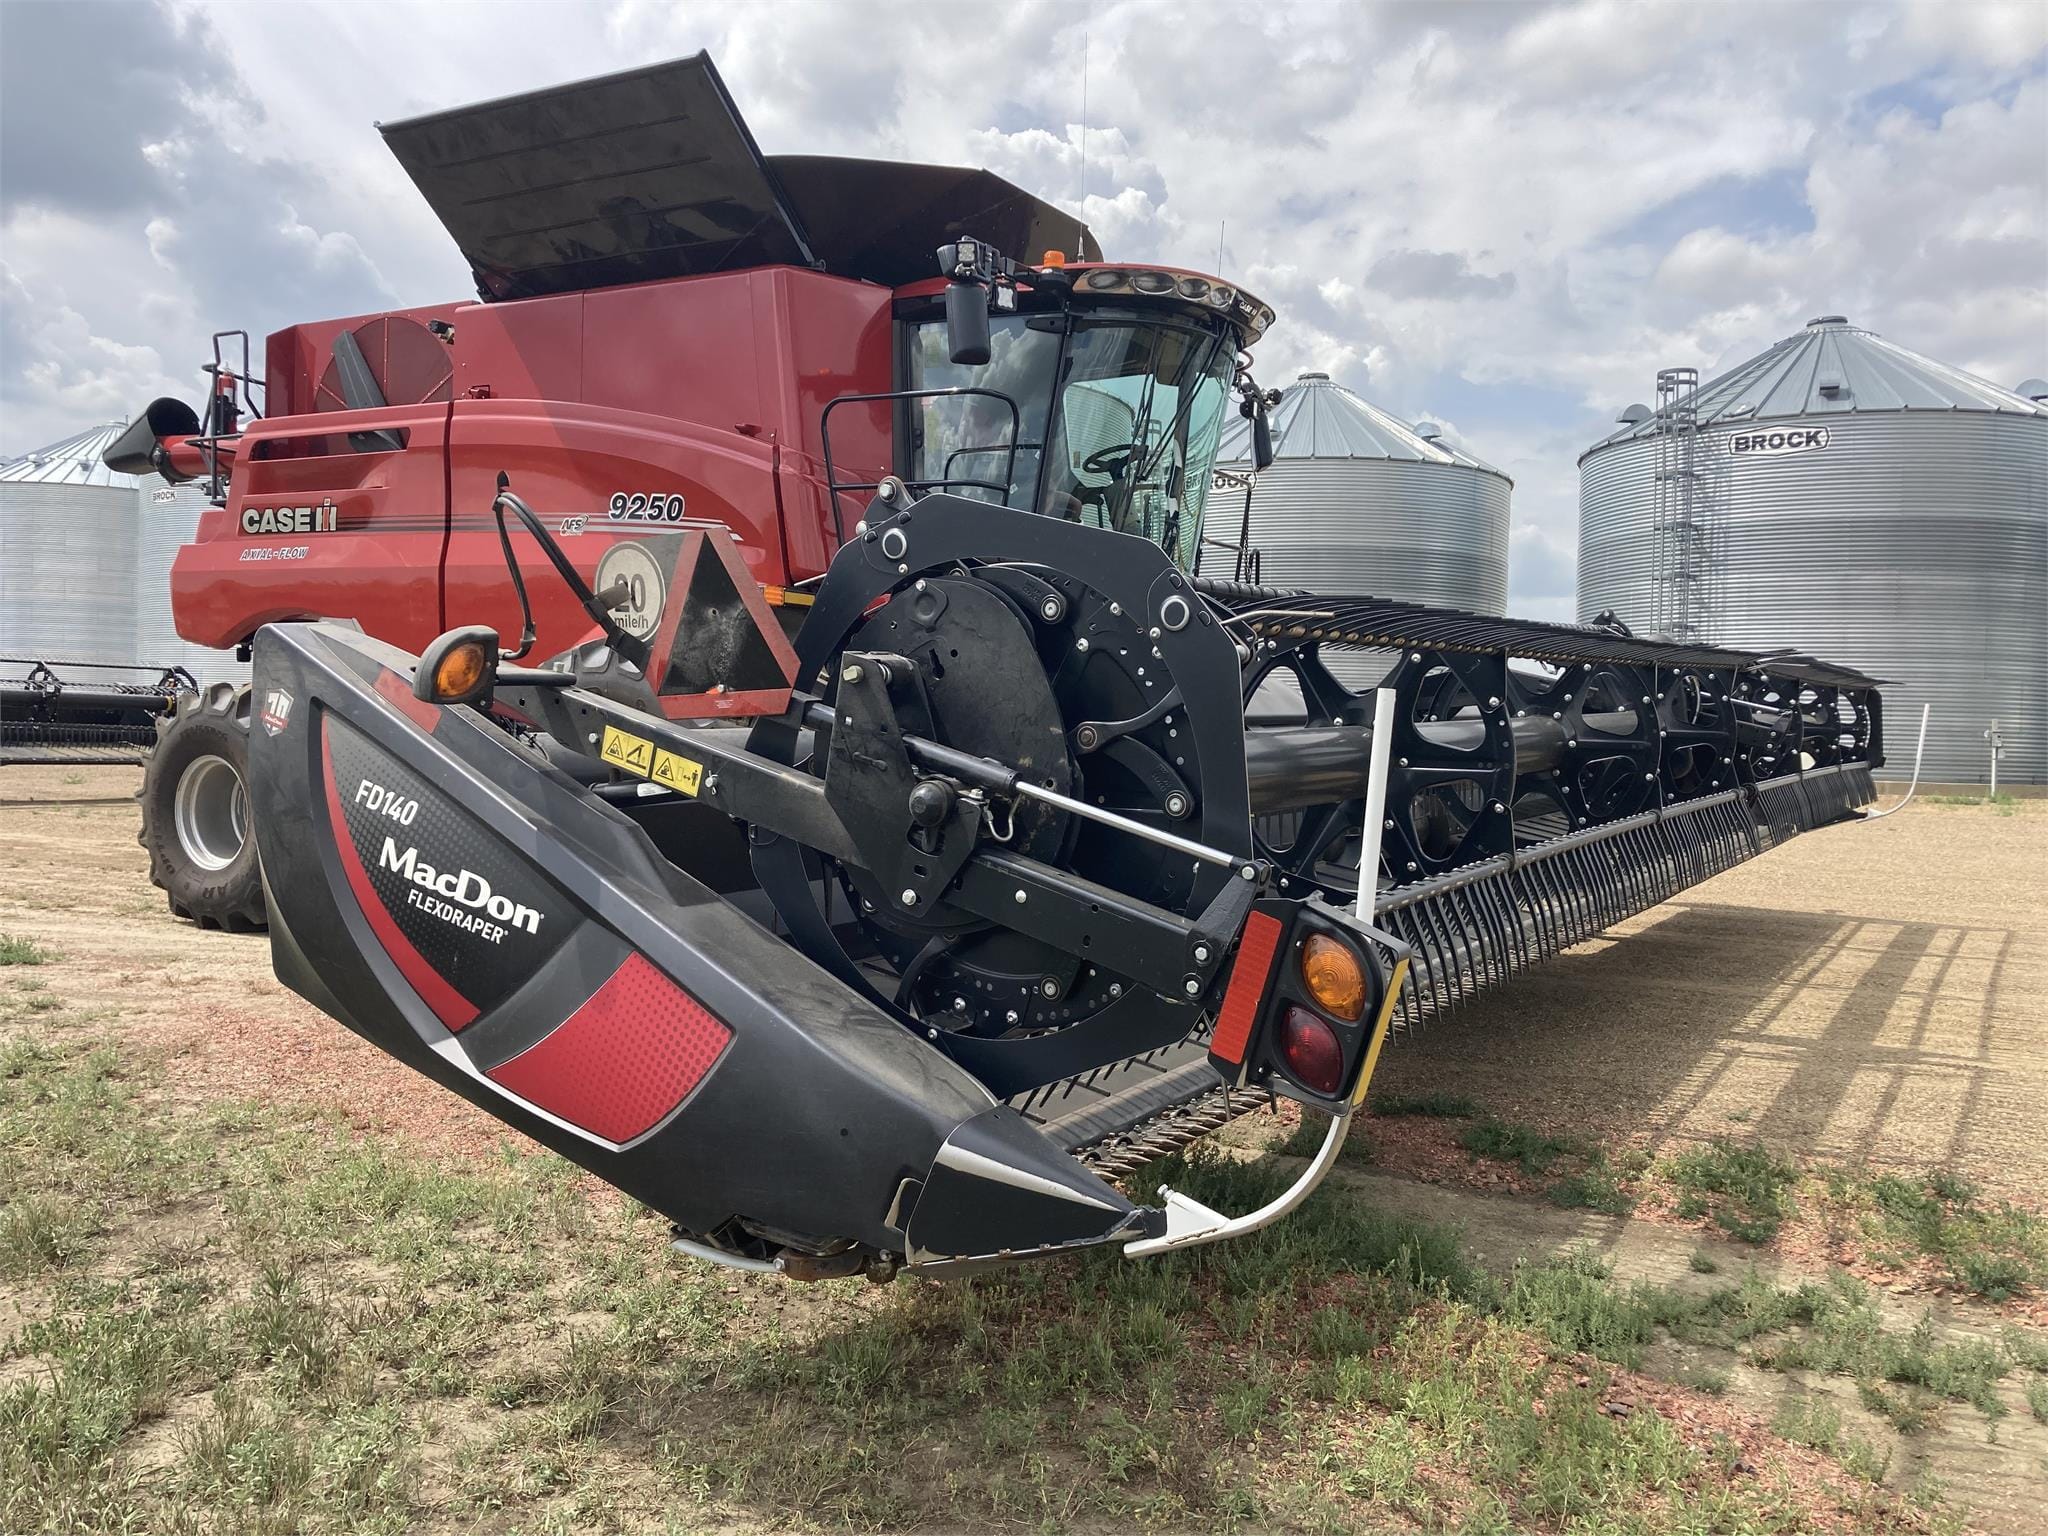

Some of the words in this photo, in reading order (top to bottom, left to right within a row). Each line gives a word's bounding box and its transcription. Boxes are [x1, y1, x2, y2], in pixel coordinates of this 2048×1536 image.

[1734, 430, 1824, 452] BROCK
[152, 491, 176, 501] BROCK
[608, 492, 685, 522] 9250
[242, 507, 311, 534] CASE
[561, 518, 584, 530] AFS
[614, 614, 649, 629] mile/h
[355, 779, 419, 826] FD140
[379, 836, 541, 934] MacDon
[407, 889, 504, 944] FLEXDRAPER
